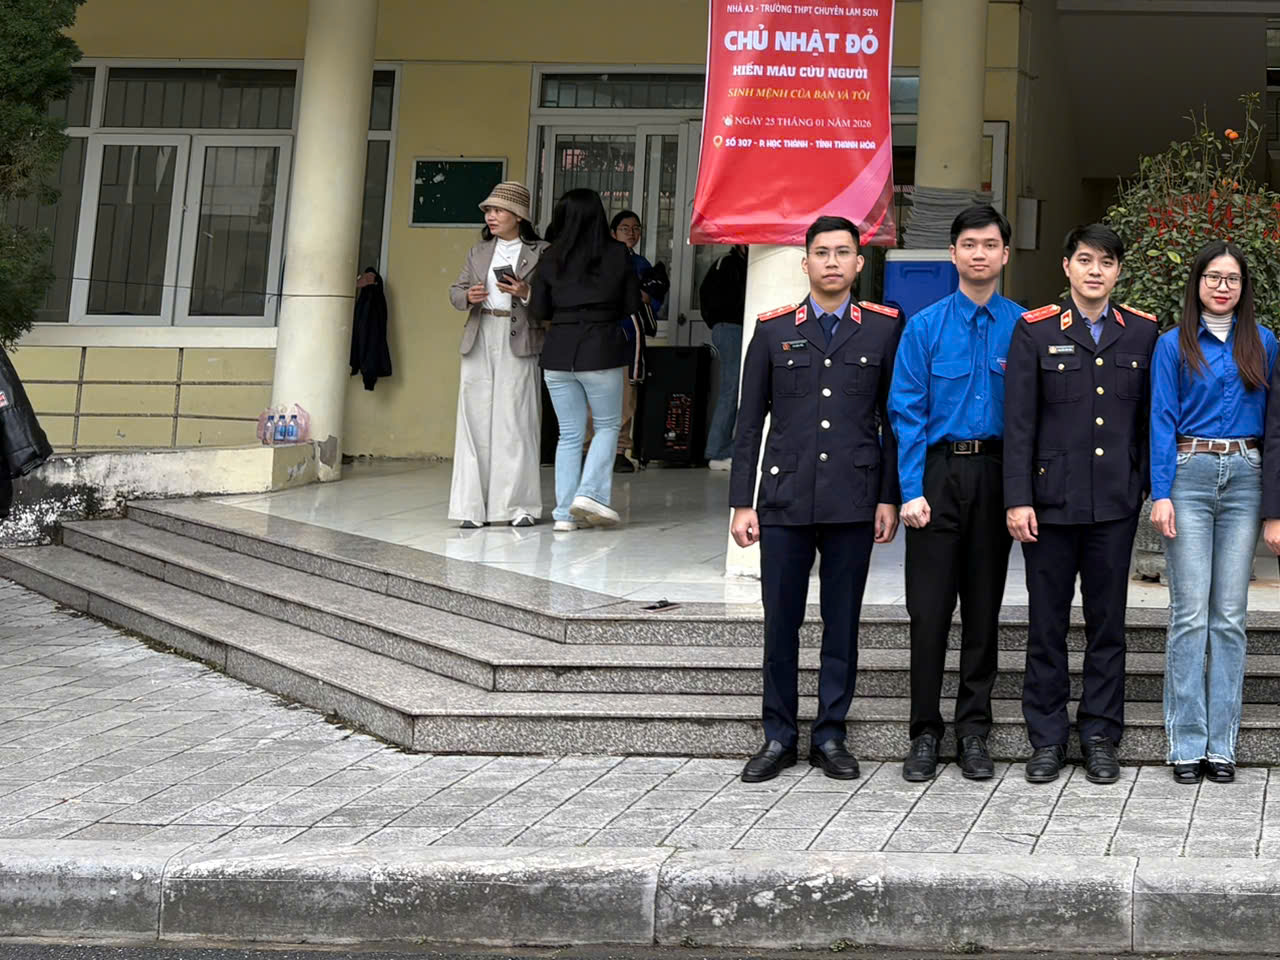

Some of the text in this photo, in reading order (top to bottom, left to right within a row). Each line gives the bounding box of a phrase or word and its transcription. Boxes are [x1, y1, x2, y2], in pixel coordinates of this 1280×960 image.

[744, 5, 754, 13] A3
[794, 5, 812, 15] THPT
[814, 5, 844, 16] CHUYÊN
[724, 24, 879, 56] CHỦ NHẬT ĐỎ
[733, 61, 764, 76] HIẾN
[728, 87, 753, 97] SINH
[756, 87, 788, 99] MỆNH
[814, 90, 835, 101] BẠN
[837, 89, 849, 100] VÀ
[852, 89, 871, 101] TÔI
[765, 117, 775, 126] 25
[815, 118, 824, 127] 01
[852, 119, 872, 128] 2026
[725, 136, 736, 147] SỐ
[738, 138, 752, 147] 307
[834, 140, 858, 149] THANH
